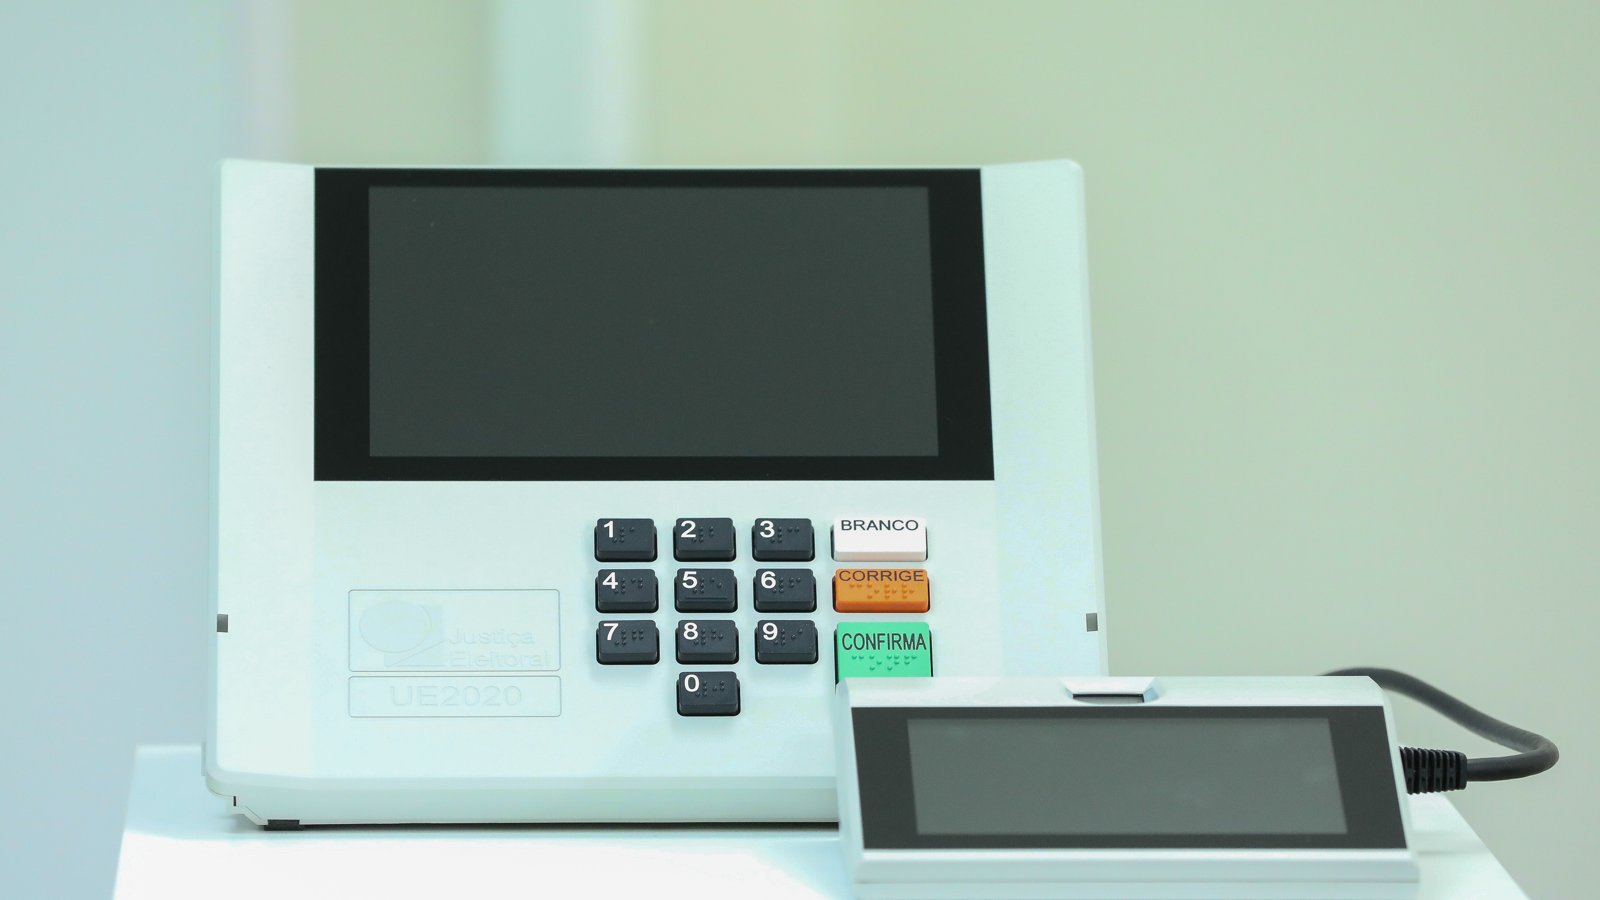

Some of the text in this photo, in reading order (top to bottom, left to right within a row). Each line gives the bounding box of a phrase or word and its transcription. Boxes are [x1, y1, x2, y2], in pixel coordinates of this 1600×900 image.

[604, 520, 614, 538] 1
[681, 520, 696, 538] 2
[760, 520, 775, 538] 3
[840, 519, 919, 531] BRANCO
[603, 571, 618, 589] 4
[683, 571, 698, 588] 5
[761, 571, 776, 589] 6
[838, 570, 925, 582] CORRIGE
[449, 627, 536, 648] Justiça
[604, 623, 618, 640] 7
[683, 622, 698, 640] 8
[762, 622, 777, 640] 9
[841, 633, 927, 651] CONFIRMA
[449, 649, 550, 667] Eleitoral
[684, 674, 700, 692] 0
[390, 685, 523, 706] UE2020
